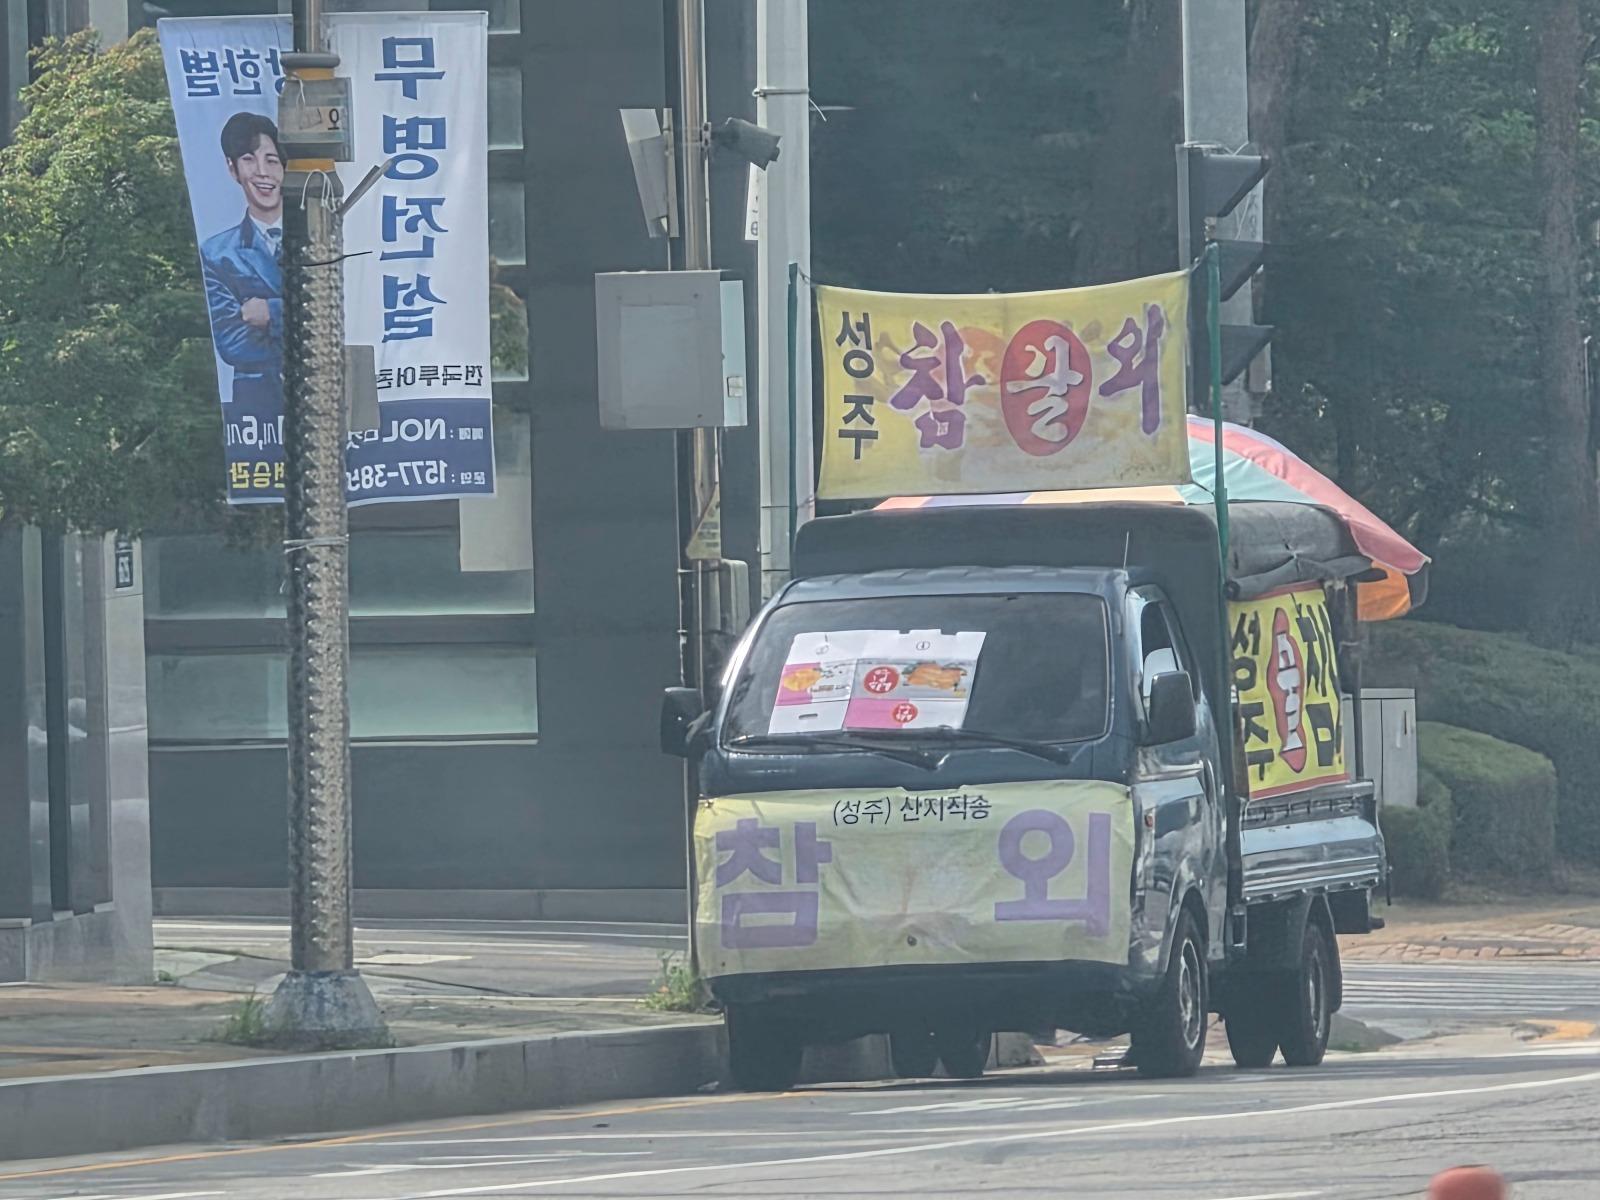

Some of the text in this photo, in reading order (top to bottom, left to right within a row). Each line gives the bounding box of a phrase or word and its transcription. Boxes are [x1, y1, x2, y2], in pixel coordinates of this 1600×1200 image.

[836, 311, 878, 460] 성주
[833, 794, 992, 826] (성주) 산지직송
